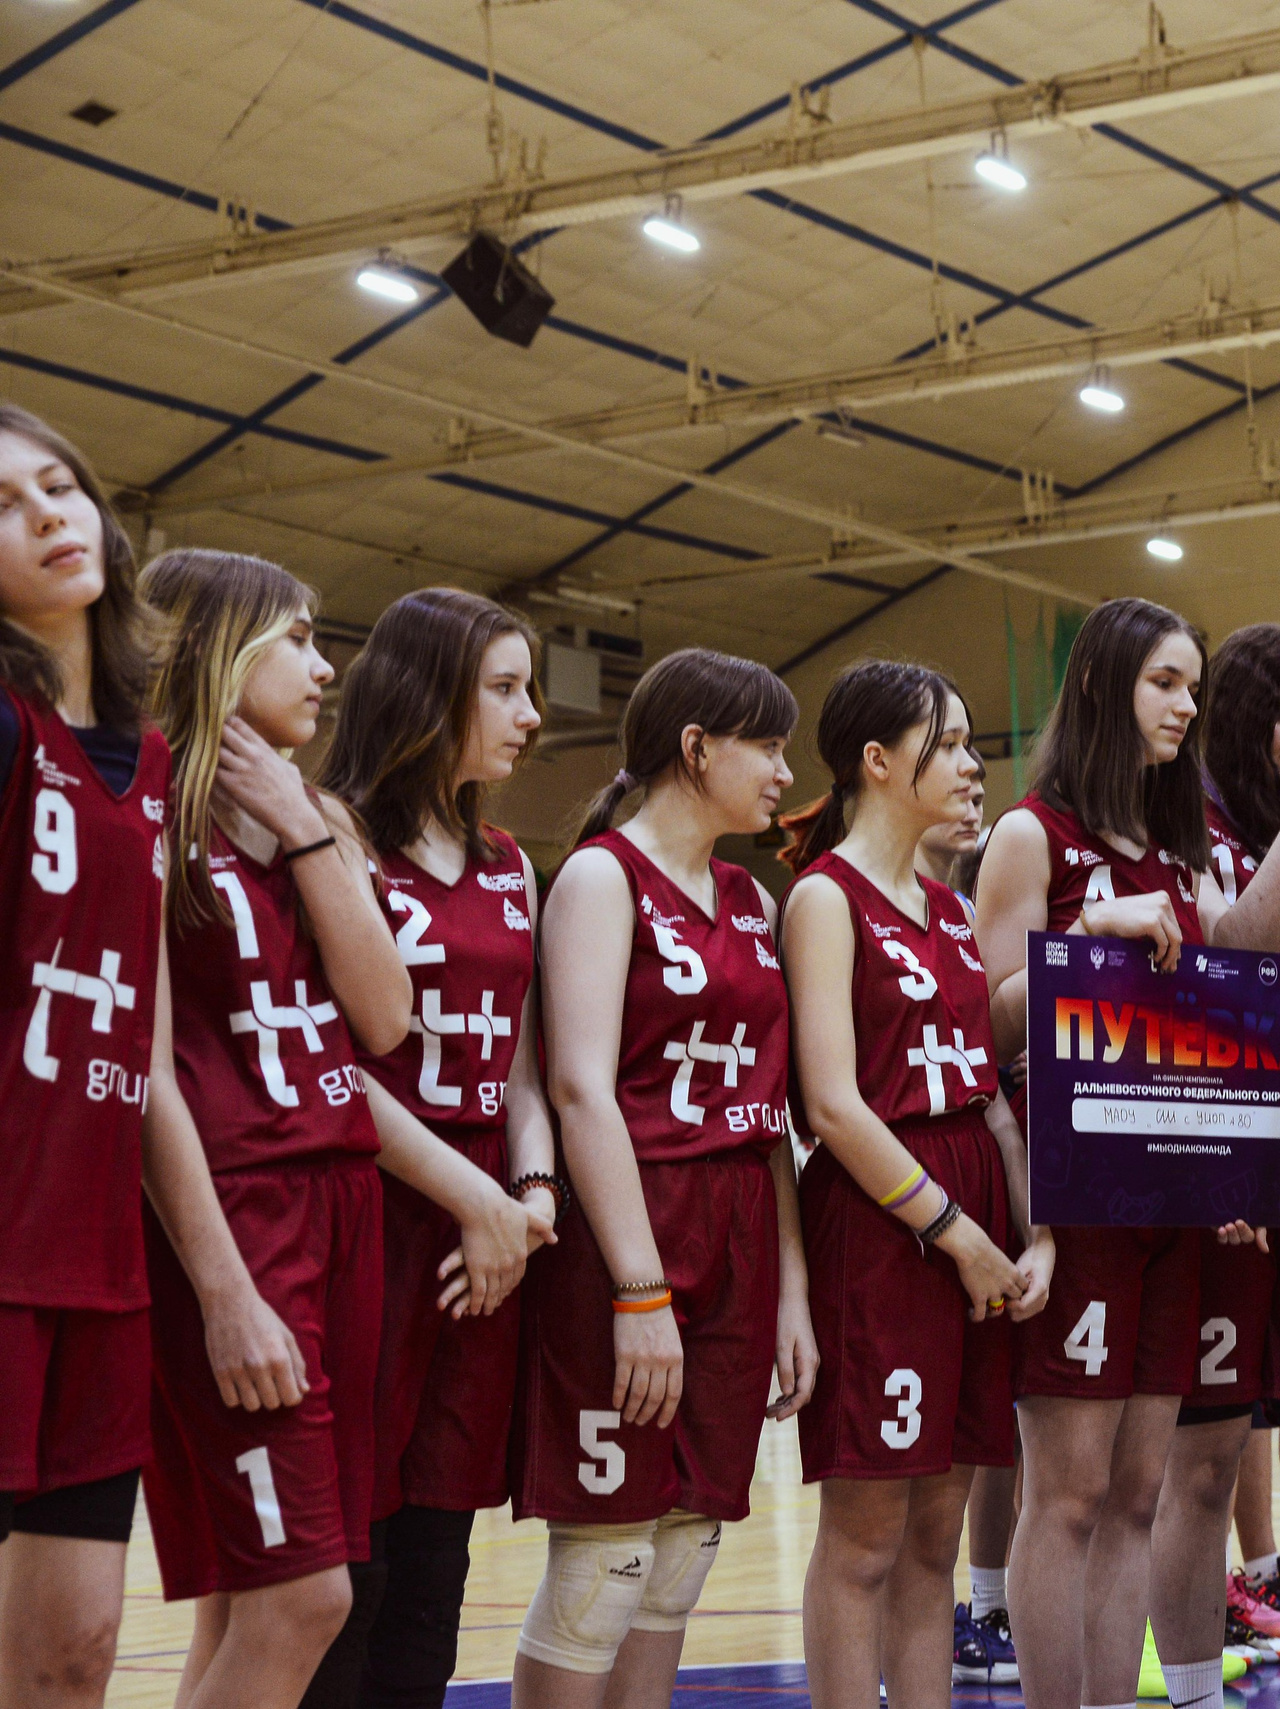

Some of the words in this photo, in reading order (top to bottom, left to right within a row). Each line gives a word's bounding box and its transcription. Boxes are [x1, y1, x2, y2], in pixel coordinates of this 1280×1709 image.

[31, 787, 79, 895] 9
[211, 871, 260, 959] 1
[388, 889, 446, 966] 2
[651, 922, 708, 995] 5
[882, 939, 938, 1001] 3
[1073, 1081, 1181, 1099] ДАЛЬНЕВОСТОЧНОГО
[1183, 1087, 1260, 1101] ФЕДЕРАЛЬНОГО
[1103, 1105, 1136, 1126] МАОУ
[1153, 1074, 1162, 1082] НА
[1163, 1075, 1184, 1084] ФИНАЛ
[1185, 1076, 1224, 1085] ЧЕМПИОНАТА
[1147, 1142, 1232, 1156] #МЫОДНАКОМАНДА
[1063, 1300, 1109, 1376] 4
[1200, 1316, 1238, 1385] 2
[880, 1368, 923, 1450] 3
[578, 1409, 626, 1496] 5
[235, 1445, 287, 1549] 1
